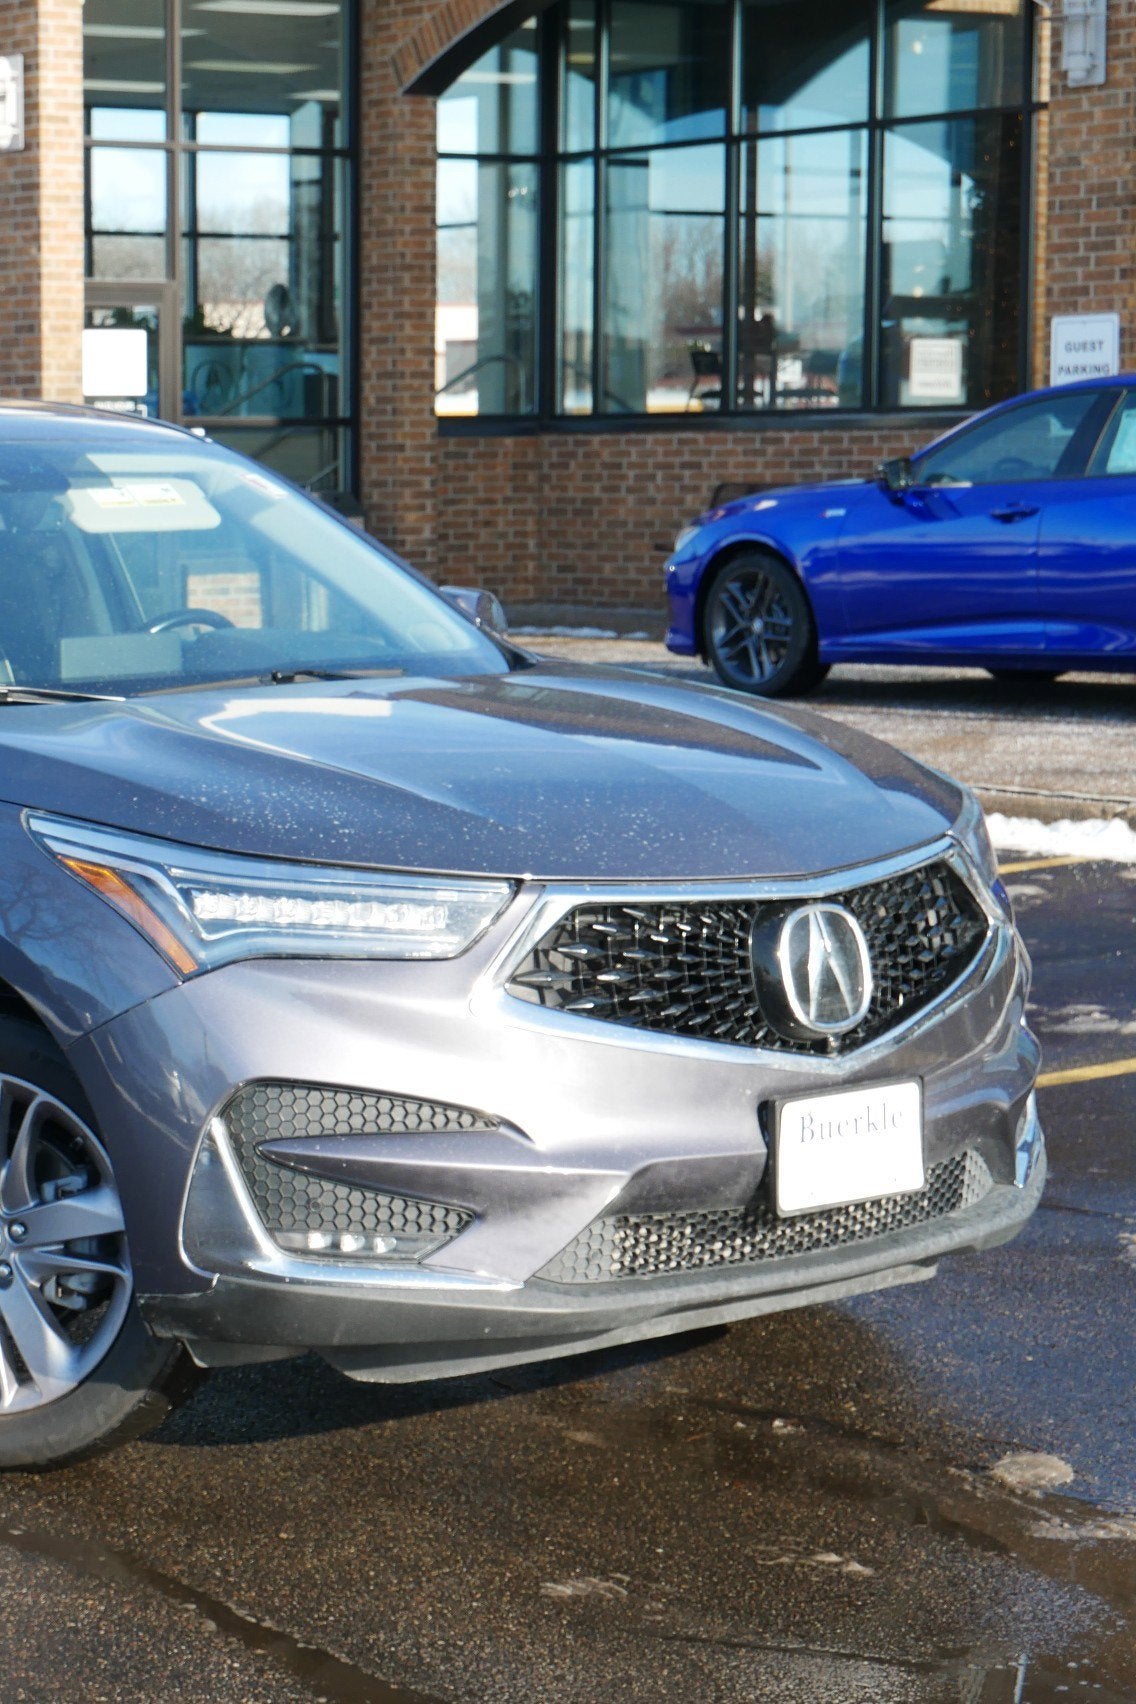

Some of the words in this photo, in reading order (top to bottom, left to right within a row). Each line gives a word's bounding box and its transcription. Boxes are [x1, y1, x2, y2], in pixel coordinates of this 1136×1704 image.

[1064, 340, 1104, 354] GUEST
[1058, 363, 1111, 376] PARKING
[800, 1102, 903, 1143] Buerkle
